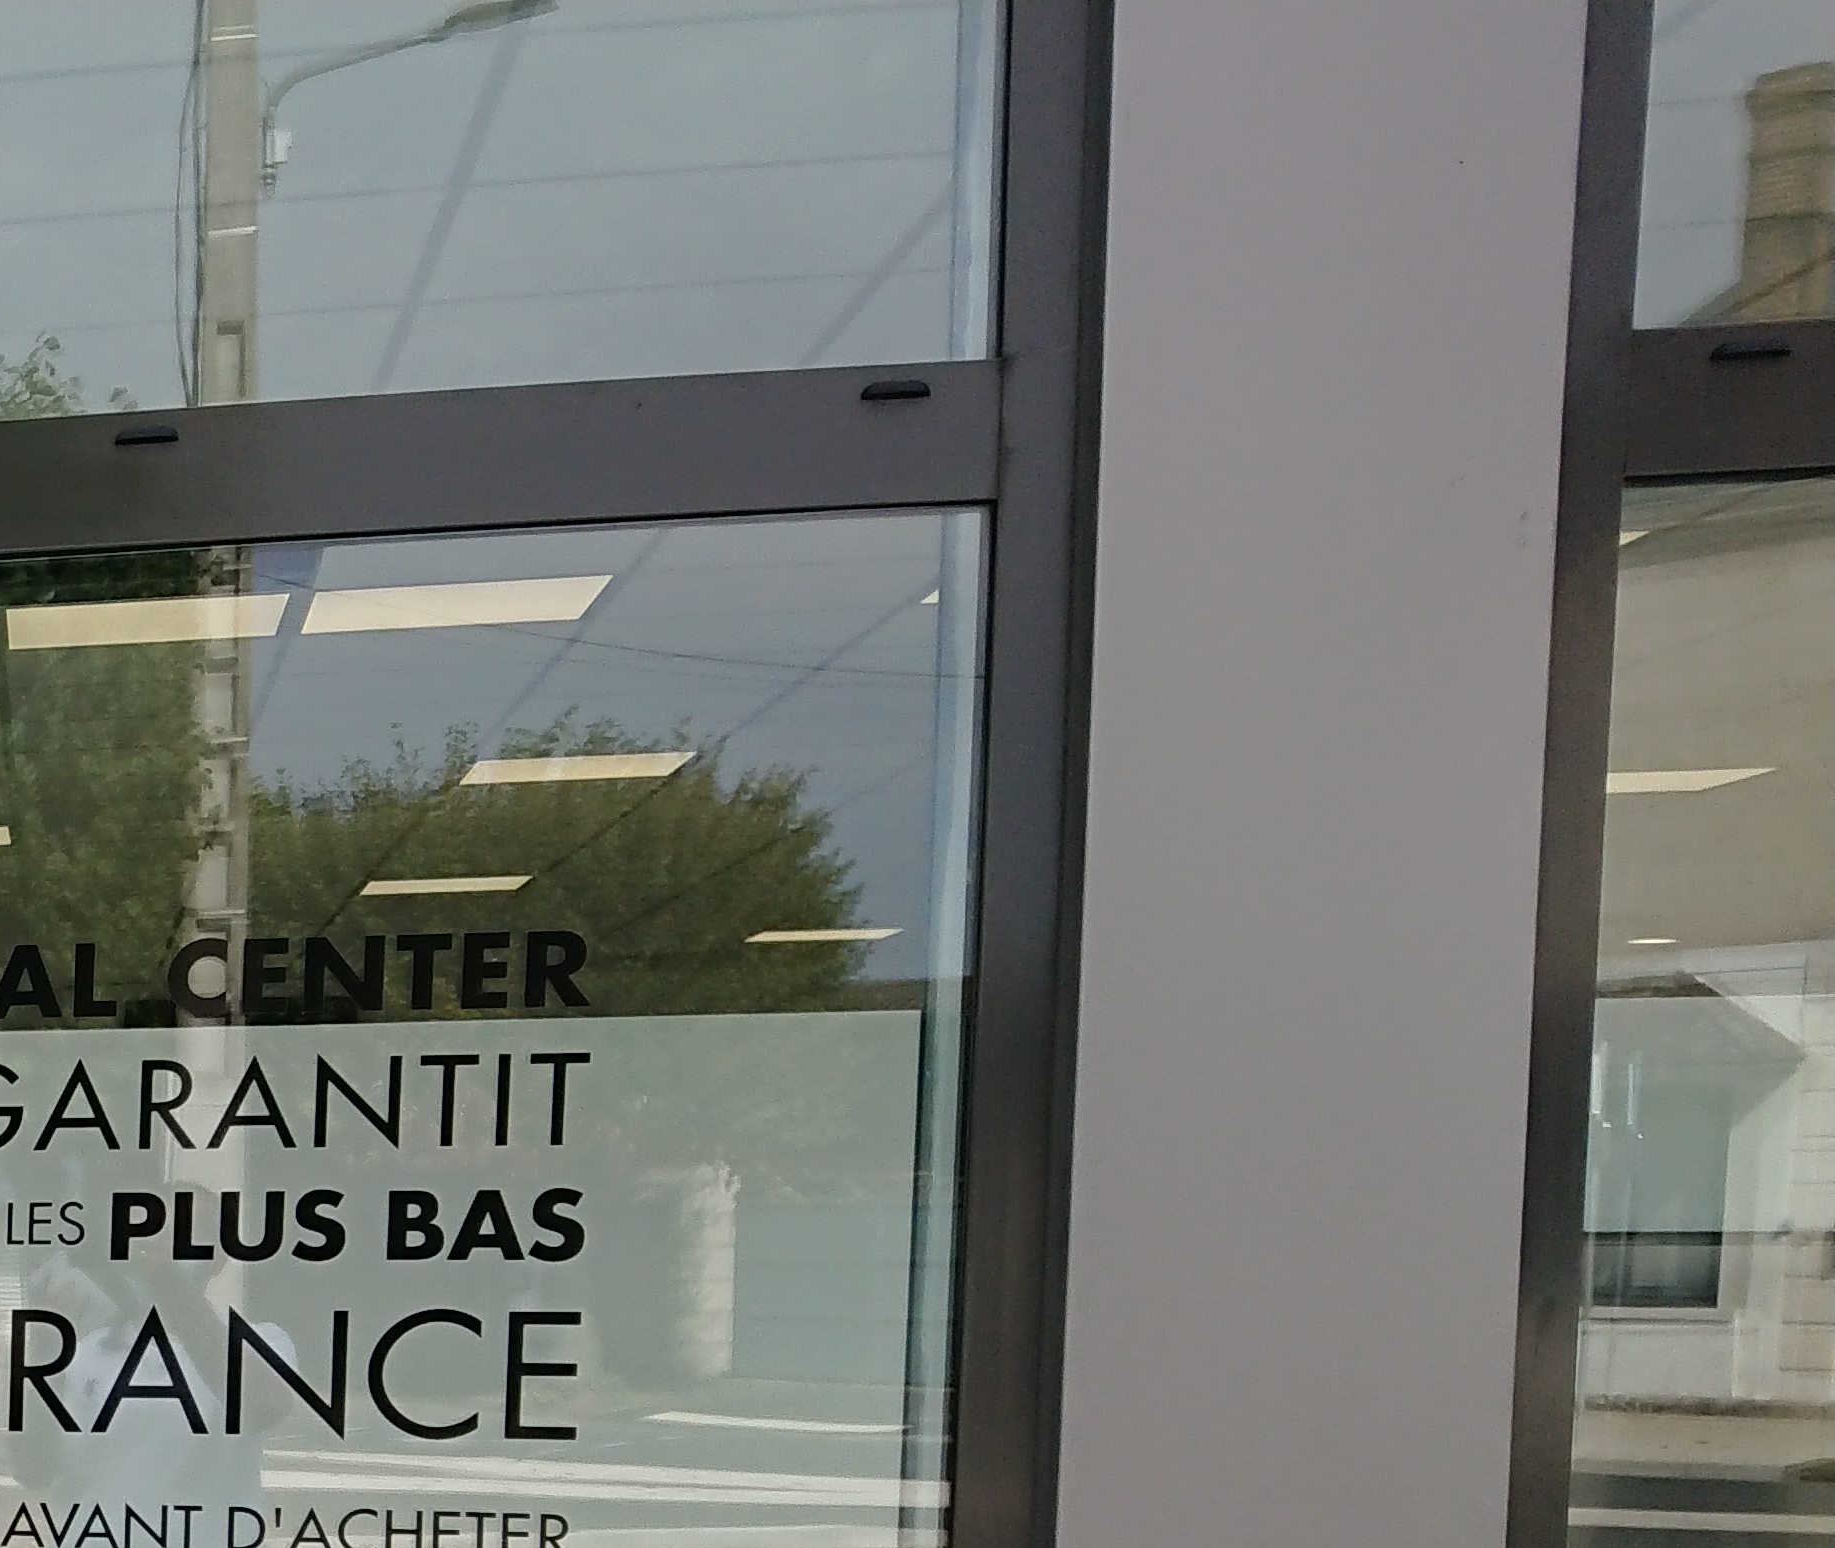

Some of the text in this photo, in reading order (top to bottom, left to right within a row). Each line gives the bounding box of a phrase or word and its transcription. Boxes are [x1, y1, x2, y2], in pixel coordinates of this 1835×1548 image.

[167, 931, 591, 1025] CENTER
[7, 1200, 84, 1246] LES
[111, 1188, 346, 1262] PLUS
[386, 1188, 585, 1261] BAS
